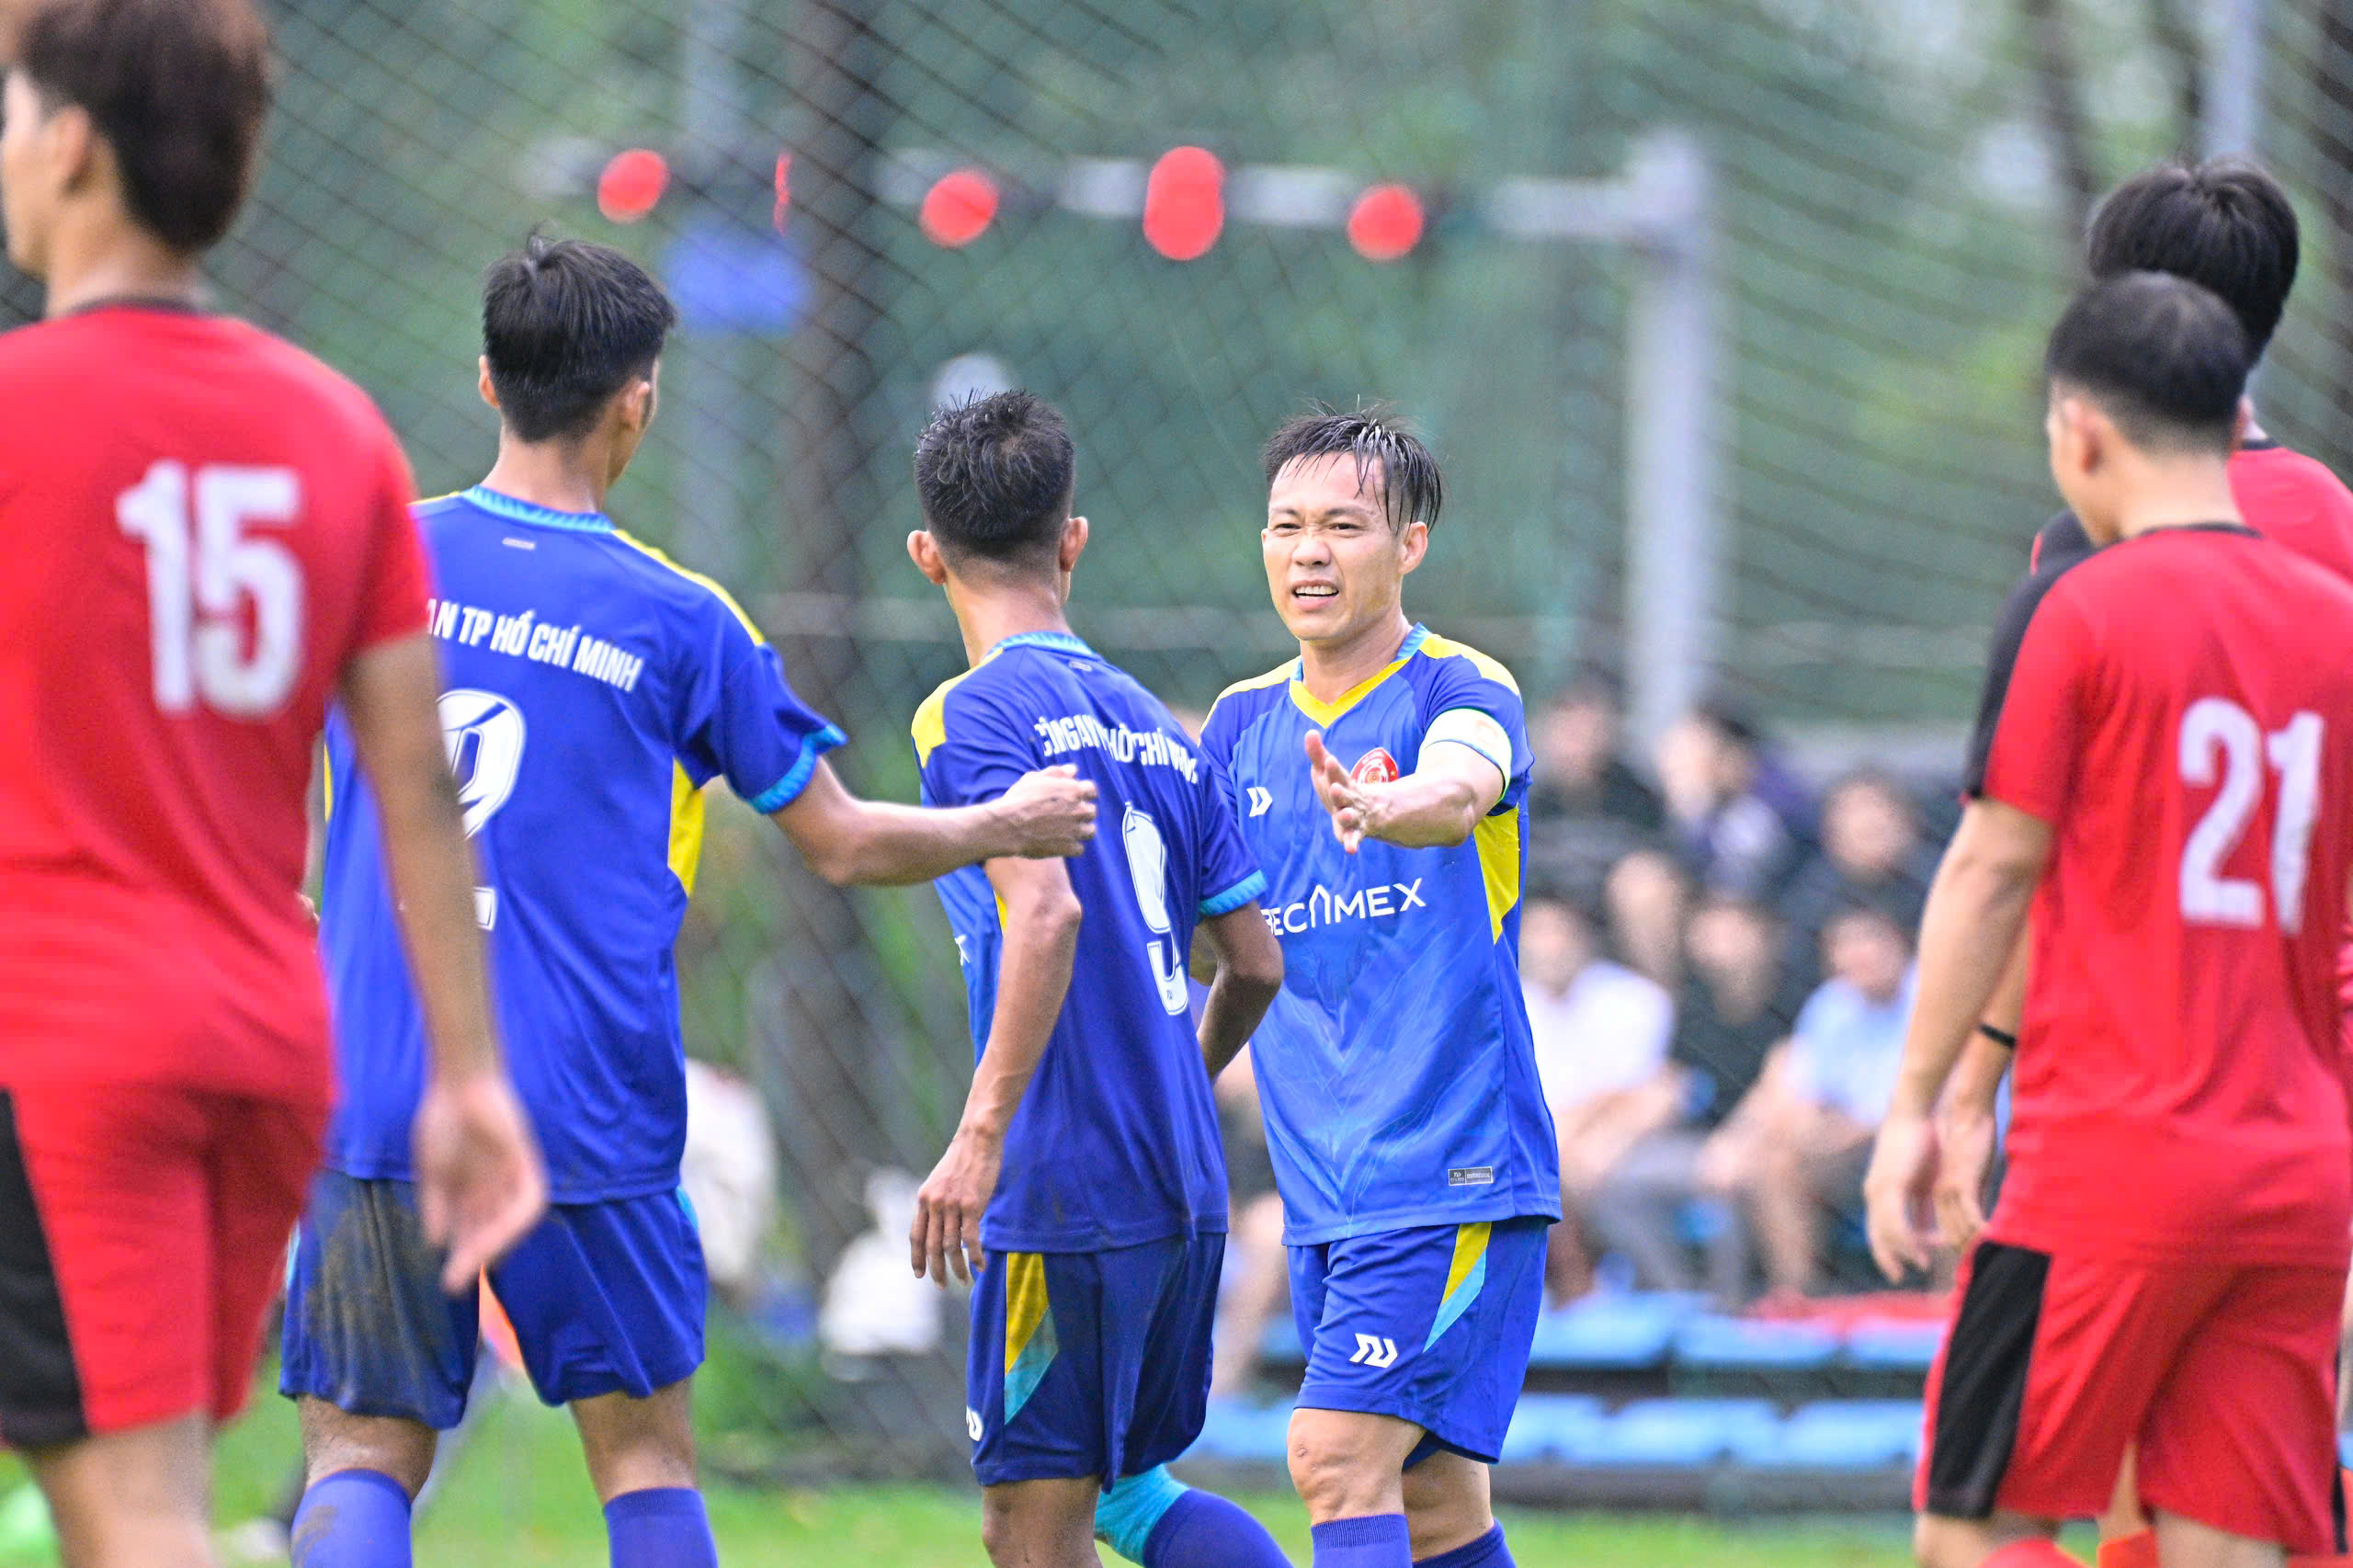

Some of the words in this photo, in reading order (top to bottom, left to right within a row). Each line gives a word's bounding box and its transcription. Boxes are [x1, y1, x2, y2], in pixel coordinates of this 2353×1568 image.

[116, 460, 303, 717] 15
[459, 607, 494, 647] TP
[527, 623, 580, 670] CHÍ
[572, 635, 643, 693] MINH
[1121, 801, 1189, 1016] 9
[2178, 696, 2325, 937] 21
